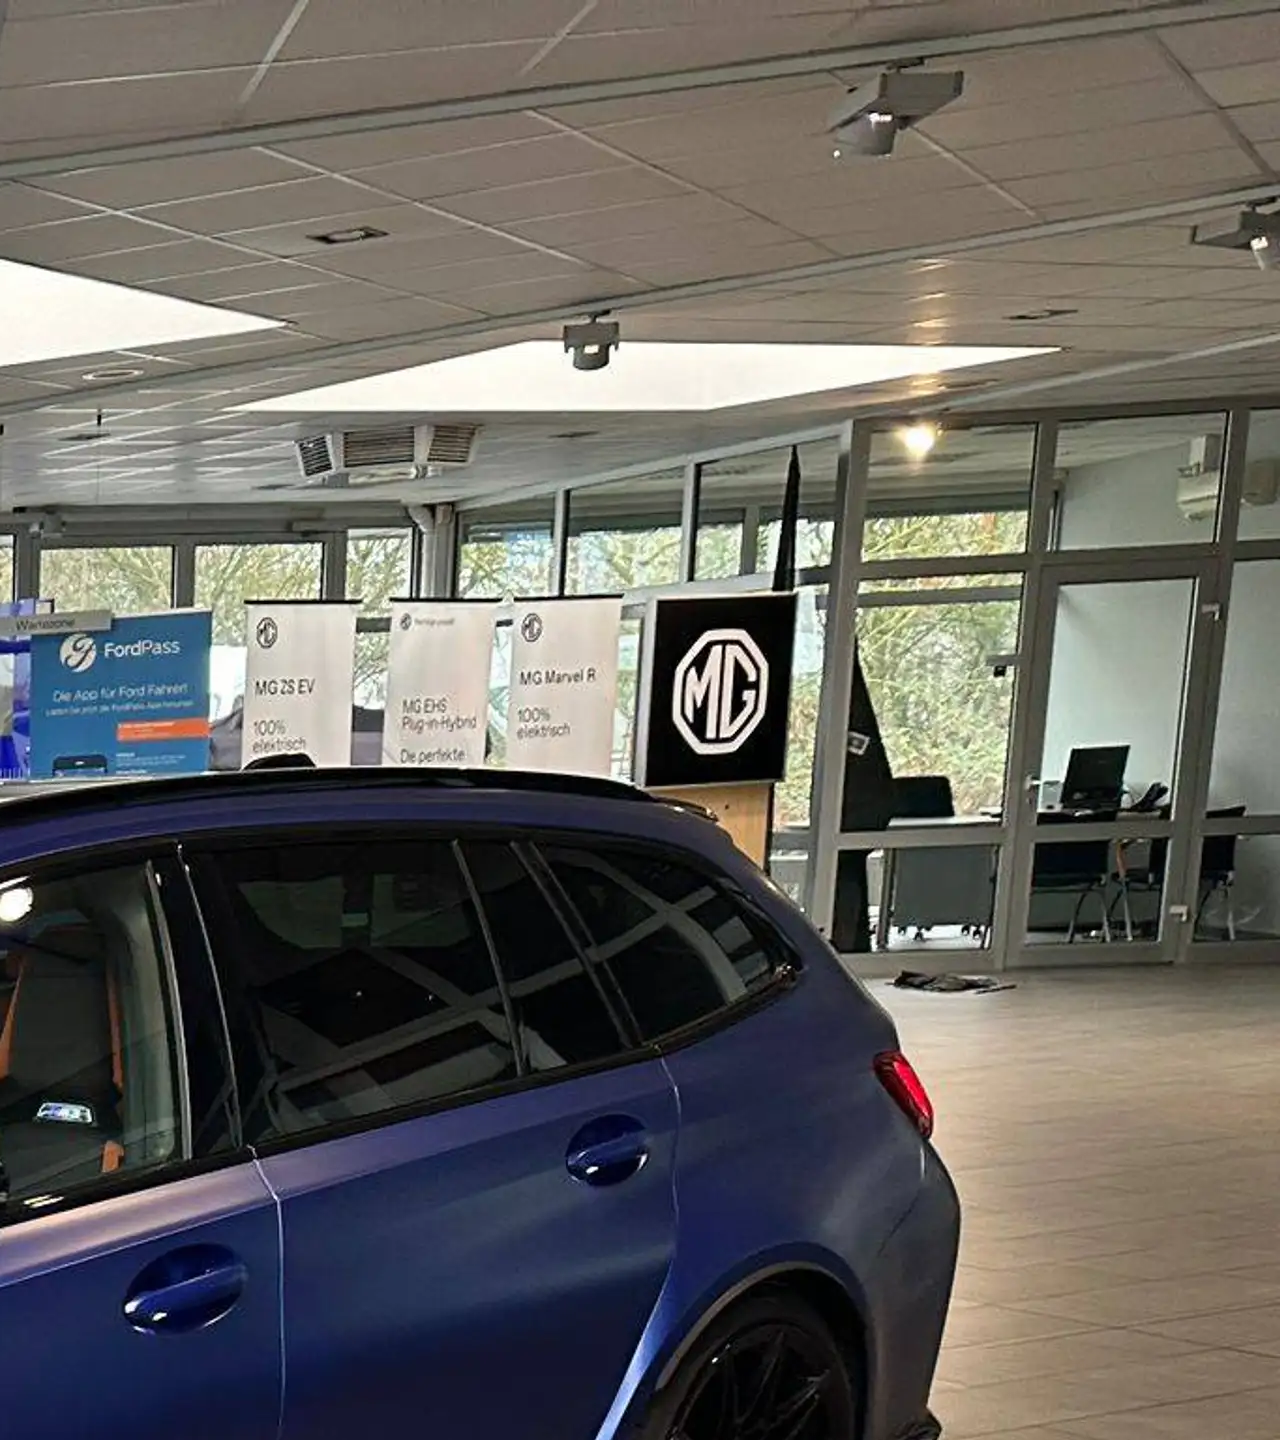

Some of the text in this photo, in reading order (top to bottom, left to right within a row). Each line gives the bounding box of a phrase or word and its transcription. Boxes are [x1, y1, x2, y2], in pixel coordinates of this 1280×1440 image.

[104, 639, 181, 659] FordPass
[520, 670, 542, 685] MG
[545, 669, 584, 684] Marvel
[119, 685, 145, 699] Ford
[255, 680, 278, 696] MG
[298, 678, 316, 695] EV
[680, 638, 760, 744] MG
[402, 699, 421, 714] MG
